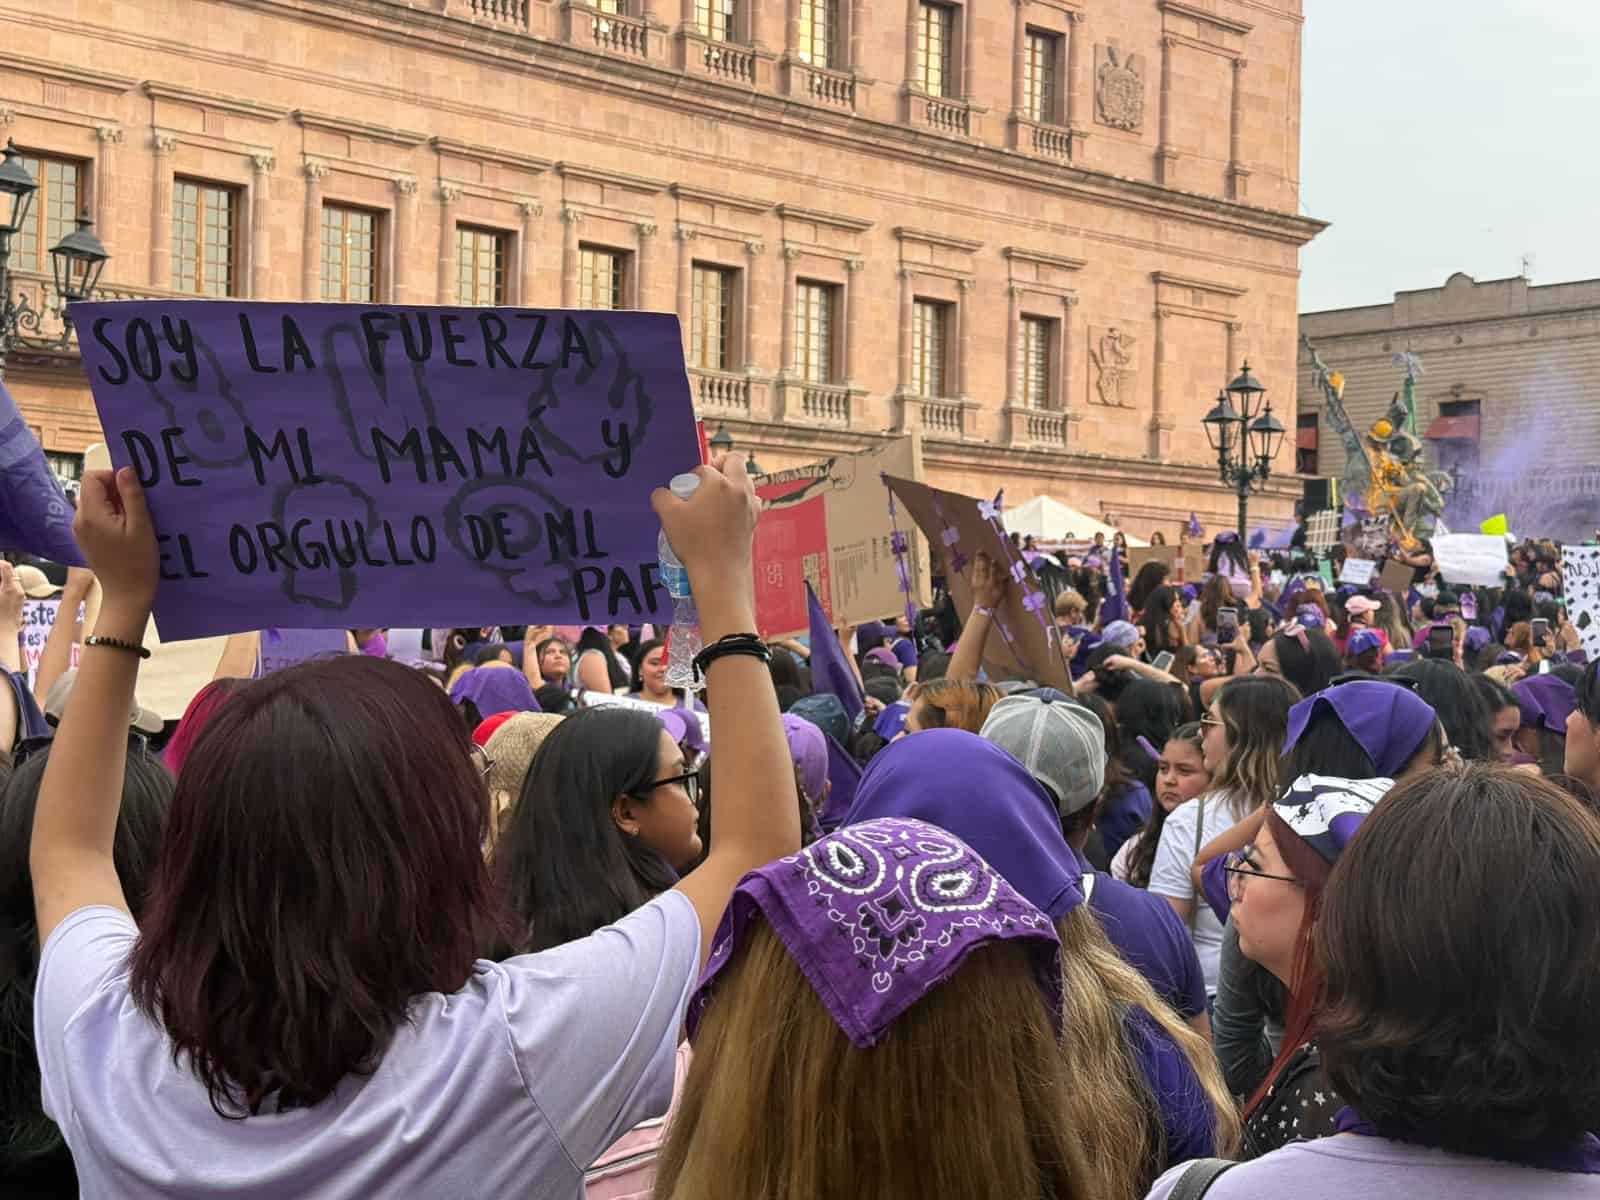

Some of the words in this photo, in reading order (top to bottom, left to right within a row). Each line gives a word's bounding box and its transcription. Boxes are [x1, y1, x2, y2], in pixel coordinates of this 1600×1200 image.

[92, 314, 199, 385] SOY
[238, 312, 316, 373] LA
[360, 311, 597, 376] FUERZA
[121, 427, 203, 488] DE
[244, 426, 324, 486] MI
[371, 404, 553, 484] MAMÁ
[156, 533, 208, 580] EL
[229, 505, 436, 575] ORGULLO
[464, 510, 520, 561] DE
[544, 507, 608, 560] MI
